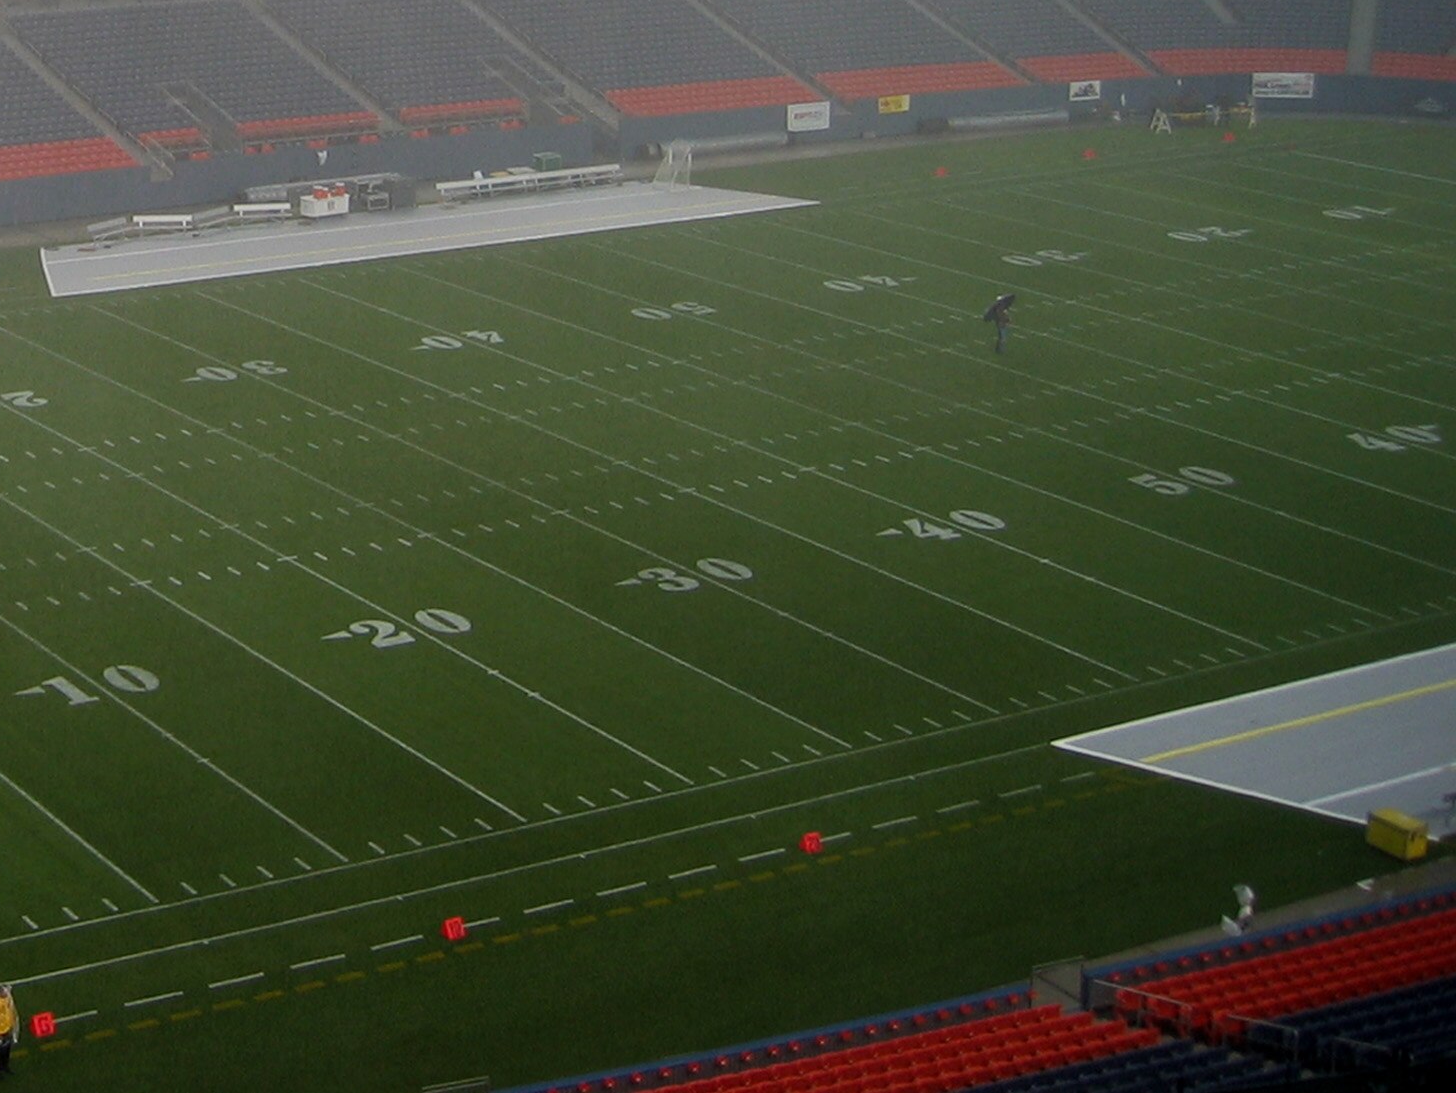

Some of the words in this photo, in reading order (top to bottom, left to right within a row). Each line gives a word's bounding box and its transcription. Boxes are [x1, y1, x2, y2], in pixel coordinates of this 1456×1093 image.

[1127, 465, 1235, 496] 50
[902, 509, 1006, 541] 40
[637, 557, 754, 593] 30
[348, 608, 473, 649] 20
[41, 664, 161, 706] 10
